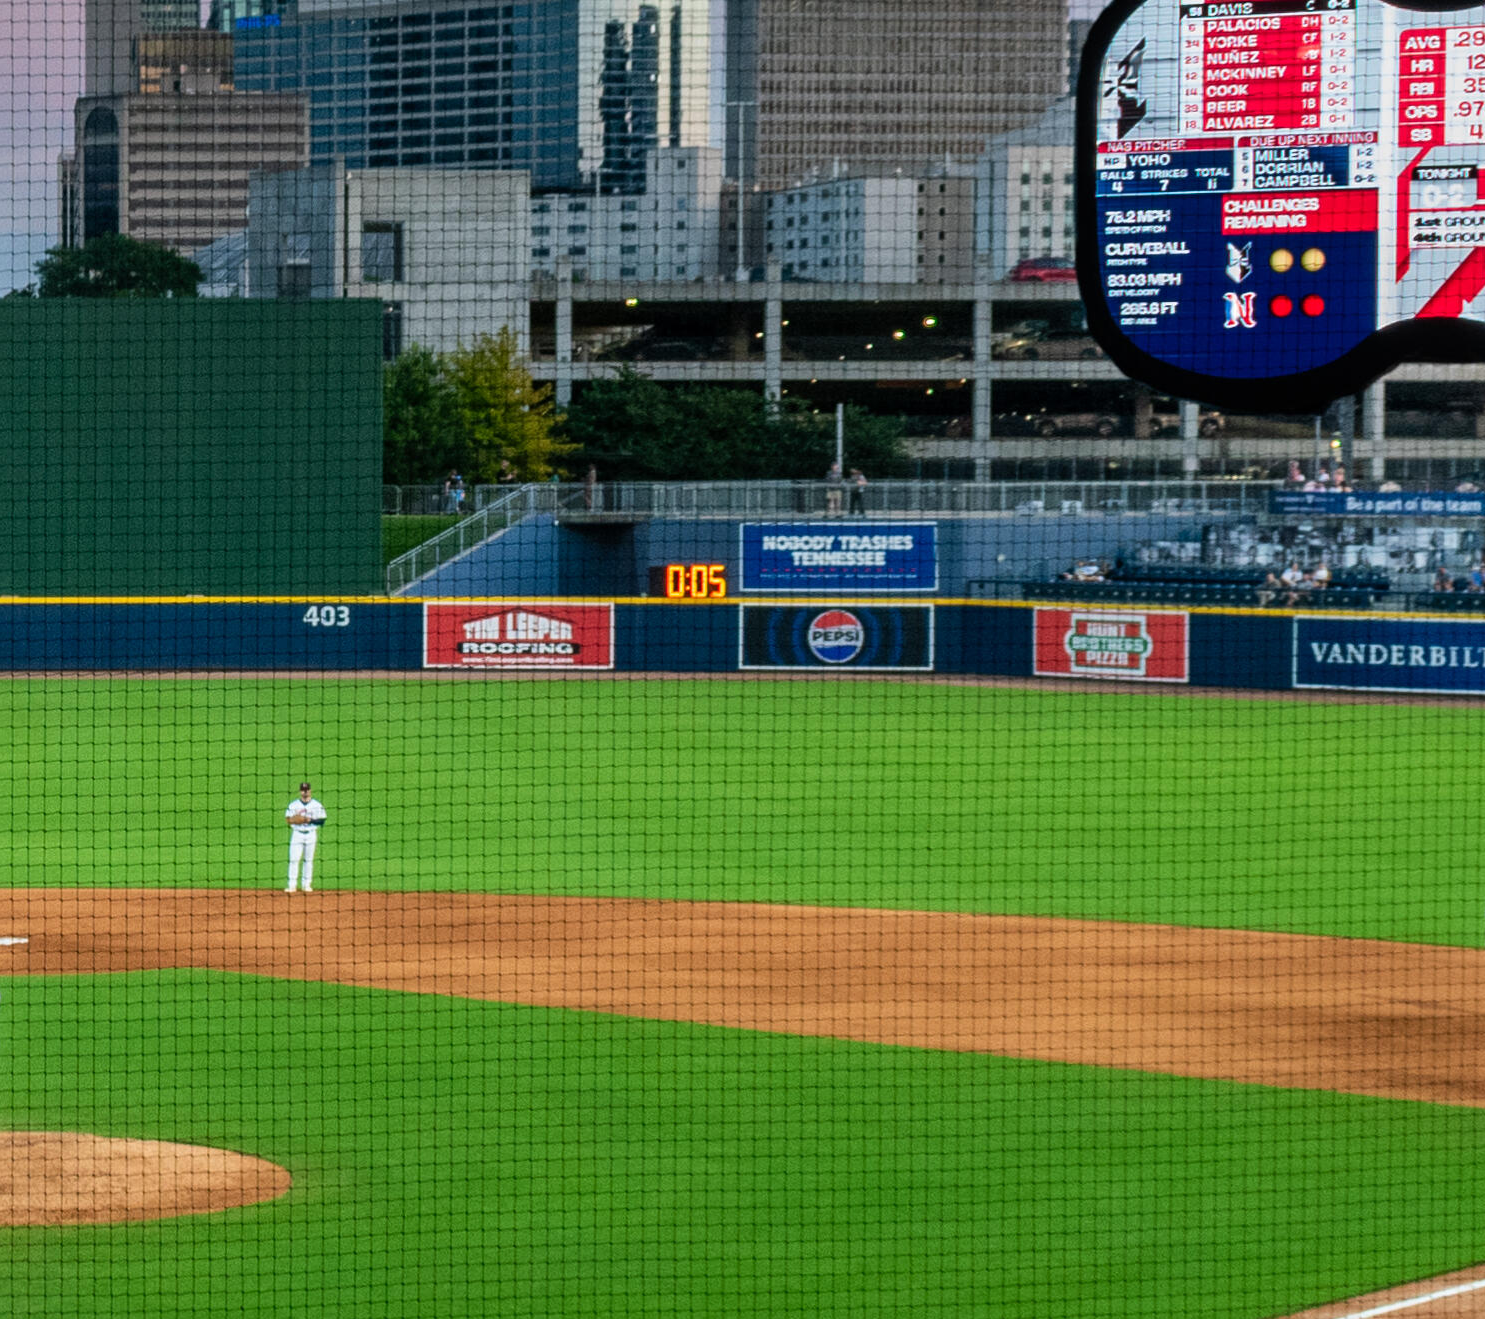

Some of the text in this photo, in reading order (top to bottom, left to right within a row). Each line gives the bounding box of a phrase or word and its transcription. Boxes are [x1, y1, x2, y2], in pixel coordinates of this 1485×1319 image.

[1208, 0, 1350, 16] DAVIS 0-2
[1207, 16, 1348, 32] PALACIOS DH 0-2
[1207, 32, 1346, 48] YORKE CF 1-2
[1405, 36, 1440, 50] AVG
[1207, 49, 1346, 64] NUÑEZ 1-2
[1207, 65, 1346, 81] MCKINNEY LF 0-1
[1411, 59, 1434, 73] HR
[1206, 82, 1347, 97] COOK RF 0-2
[1410, 82, 1435, 96] RBI
[1207, 98, 1347, 113] BEER 1B 0-2
[1405, 105, 1438, 119] OPS
[1205, 114, 1345, 129] ALVAREZ 2B 0-1
[1251, 133, 1374, 146] DUE UP NEXT INNING
[1411, 128, 1432, 142] SB
[1108, 140, 1186, 152] NAS PITCHER
[1129, 154, 1171, 166] YOHO
[1255, 149, 1309, 162] MILLER
[1100, 168, 1230, 180] BALLS STRIKES TOTAL
[1255, 162, 1324, 174] DORRIAN
[1417, 168, 1471, 180] TONIGHT
[1255, 174, 1336, 187] CAMPBELL
[1423, 184, 1464, 207] 0-2
[1224, 197, 1320, 213] CHALLENGES
[1136, 210, 1171, 223] MPH
[1224, 214, 1307, 229] REMAINING
[1414, 217, 1441, 227] 1st
[1413, 232, 1442, 243] 4th
[1105, 242, 1190, 256] CURVEBALL
[1148, 273, 1182, 286] MPH
[1160, 302, 1178, 314] FT
[1346, 497, 1363, 511] Be
[1375, 499, 1402, 513] part
[1404, 497, 1420, 511] of
[1421, 498, 1444, 511] the
[1445, 499, 1482, 512] team
[762, 535, 914, 551] NOBODY TRASHES
[791, 551, 886, 566] TENNESSEE
[666, 564, 726, 598] 0:05
[303, 606, 350, 627] 403
[463, 612, 573, 640] TIM LEEPER
[1087, 622, 1126, 637] HUNT
[812, 630, 860, 642] PEPSI
[462, 643, 573, 654] ROOFING
[1071, 636, 1144, 652] BROTHERS
[1086, 651, 1129, 665] PIZZA
